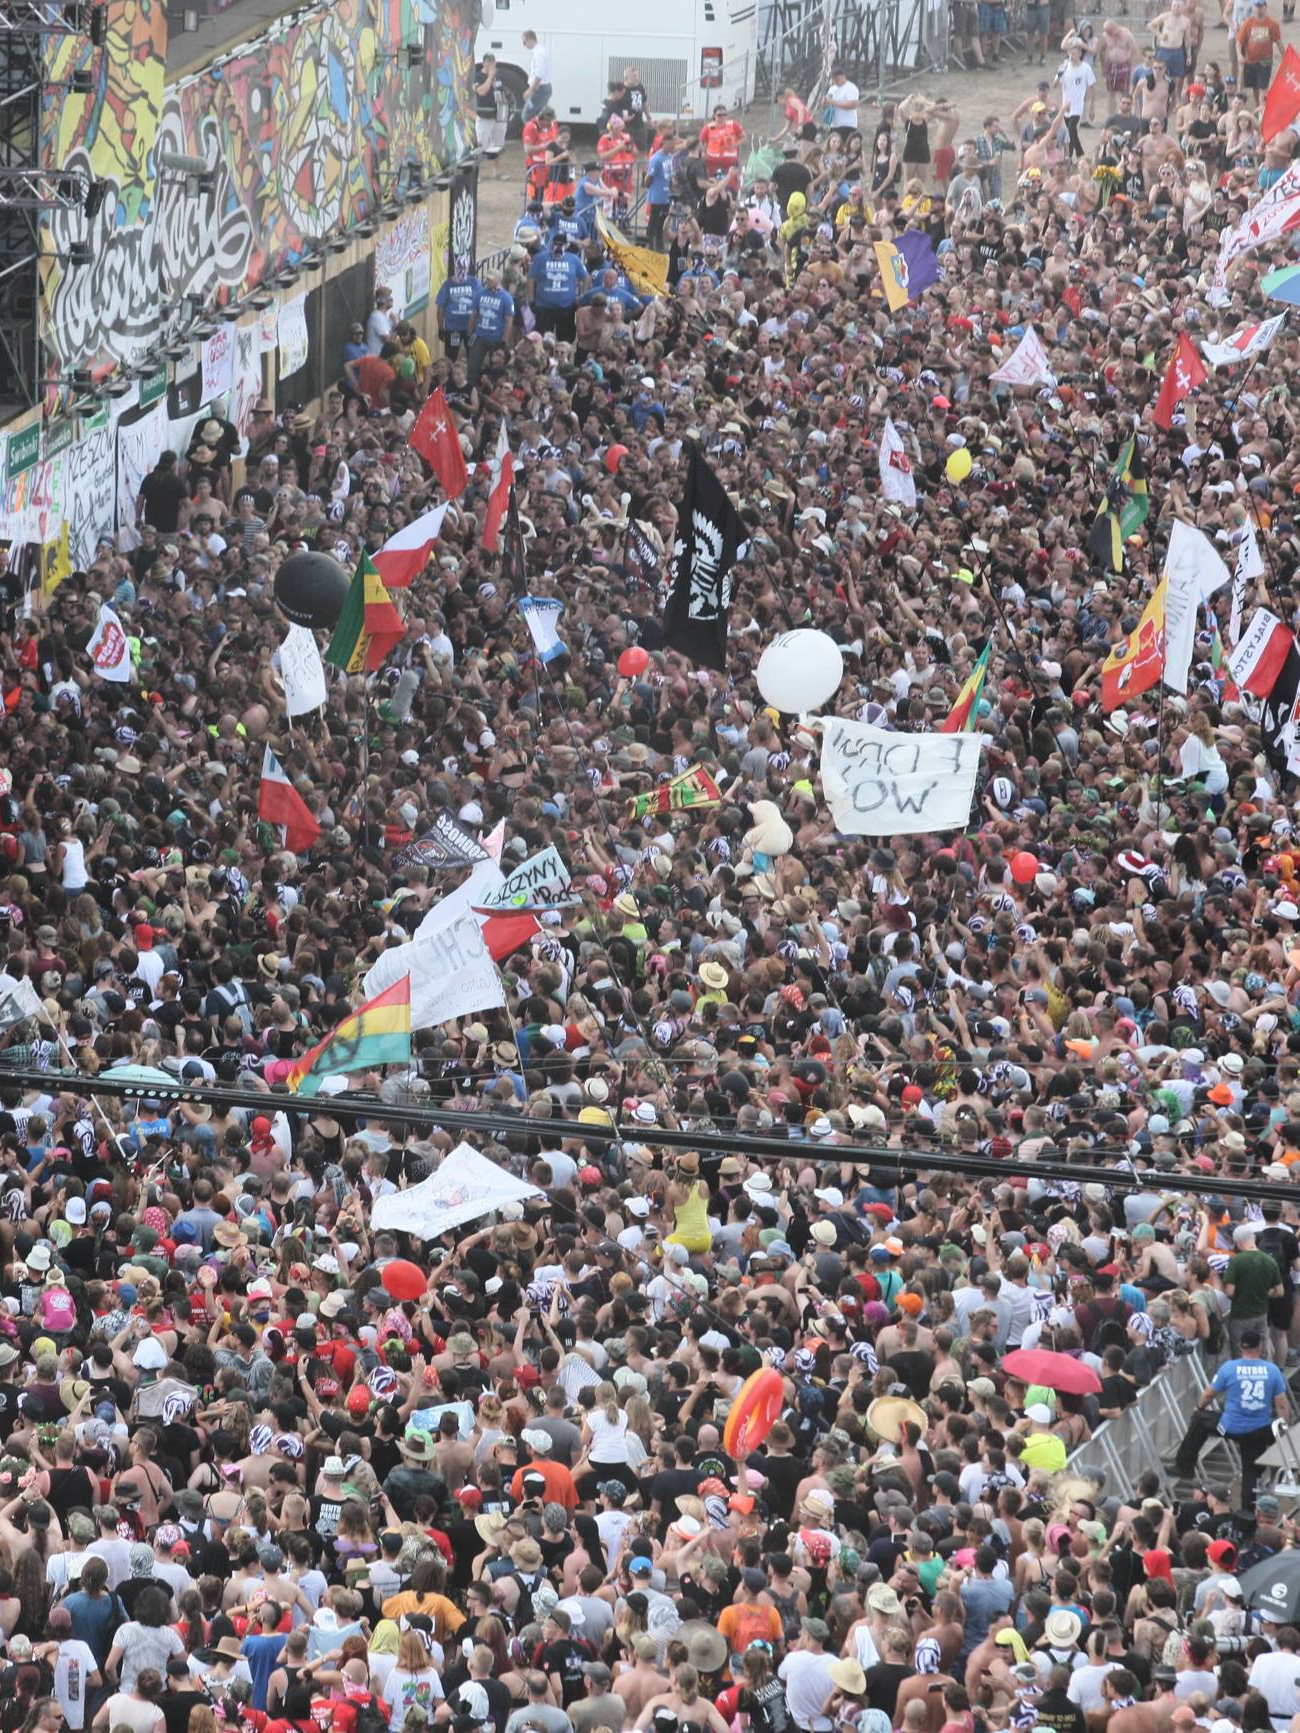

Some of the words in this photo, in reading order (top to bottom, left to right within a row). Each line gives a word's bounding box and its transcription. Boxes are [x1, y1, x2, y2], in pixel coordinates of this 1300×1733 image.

[546, 261, 569, 270] PATROL
[450, 286, 472, 295] PATROL
[480, 296, 501, 306] PATROL
[1236, 1366, 1268, 1375] PATROL
[1240, 1380, 1265, 1401] 24
[320, 1503, 342, 1514] CENTR
